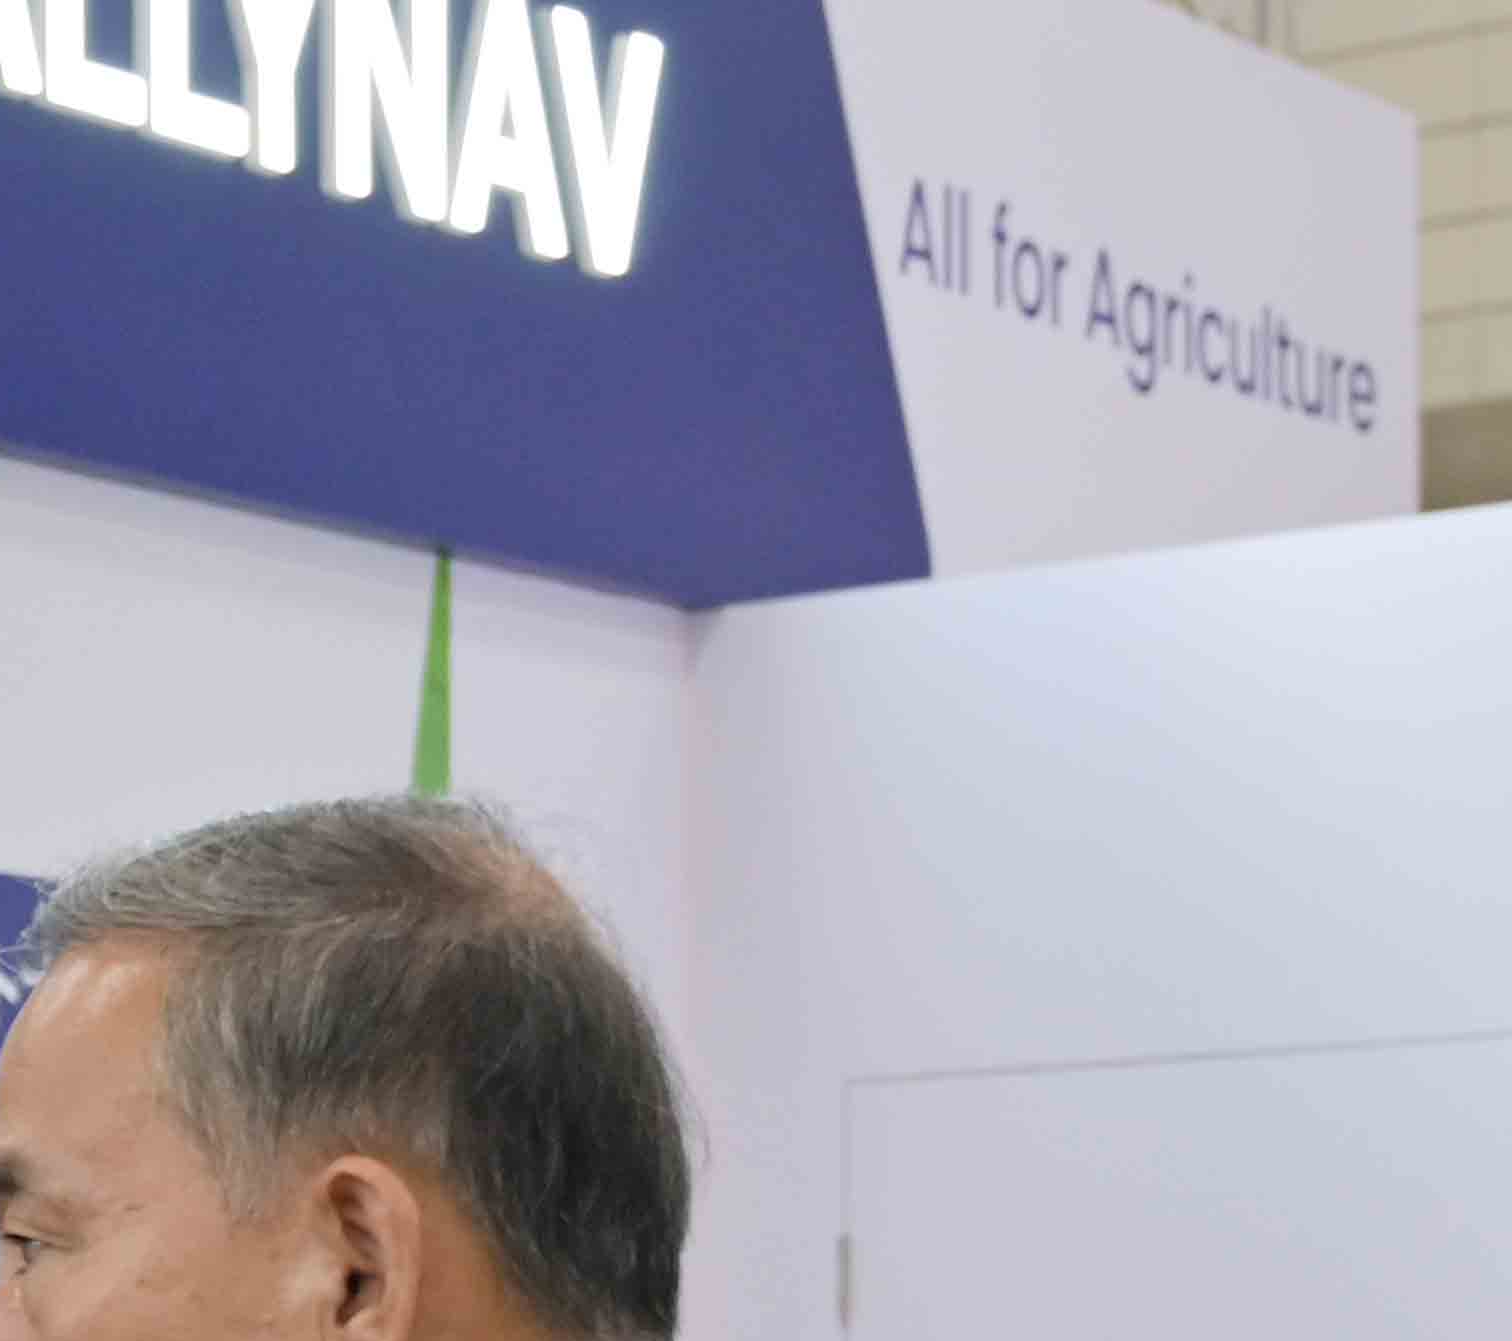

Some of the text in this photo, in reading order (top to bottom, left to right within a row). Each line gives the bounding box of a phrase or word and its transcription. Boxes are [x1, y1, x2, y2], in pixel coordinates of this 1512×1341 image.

[899, 177, 1377, 435] All for Agriculture
